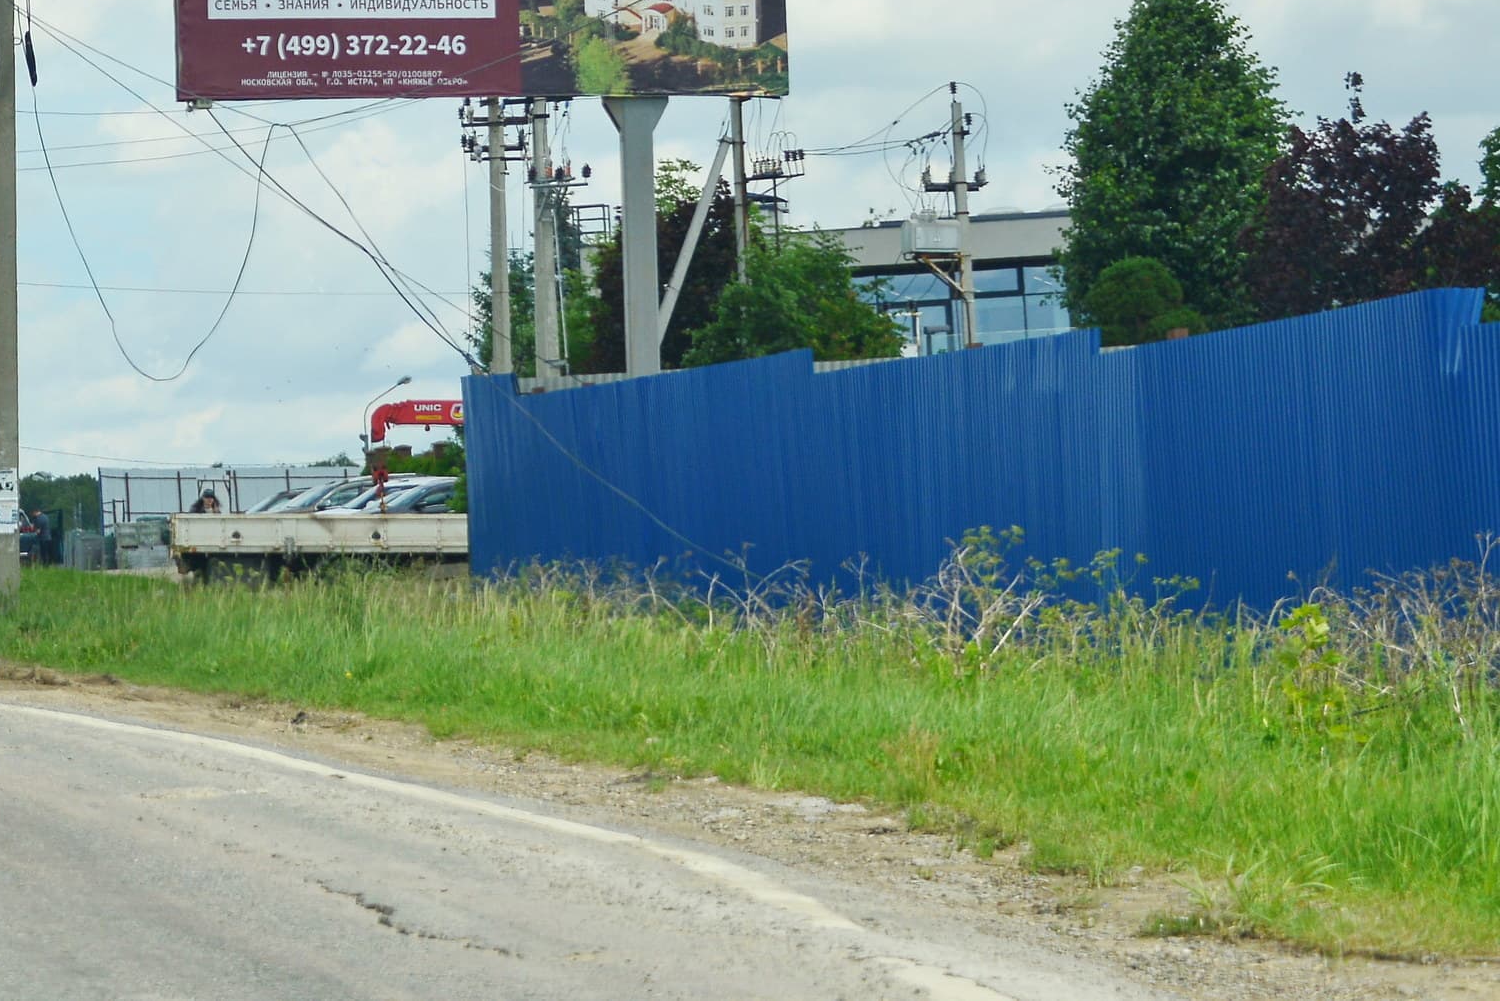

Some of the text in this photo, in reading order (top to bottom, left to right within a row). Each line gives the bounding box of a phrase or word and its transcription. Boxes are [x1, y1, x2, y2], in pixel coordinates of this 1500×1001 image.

[214, 0, 489, 12] СЕМЬЯ ЗНАНИЯ ИНДИВИДУАЛЬНОСТЬ
[241, 33, 466, 60] +7 (499) 372-22-46
[413, 404, 442, 412] UNIC
